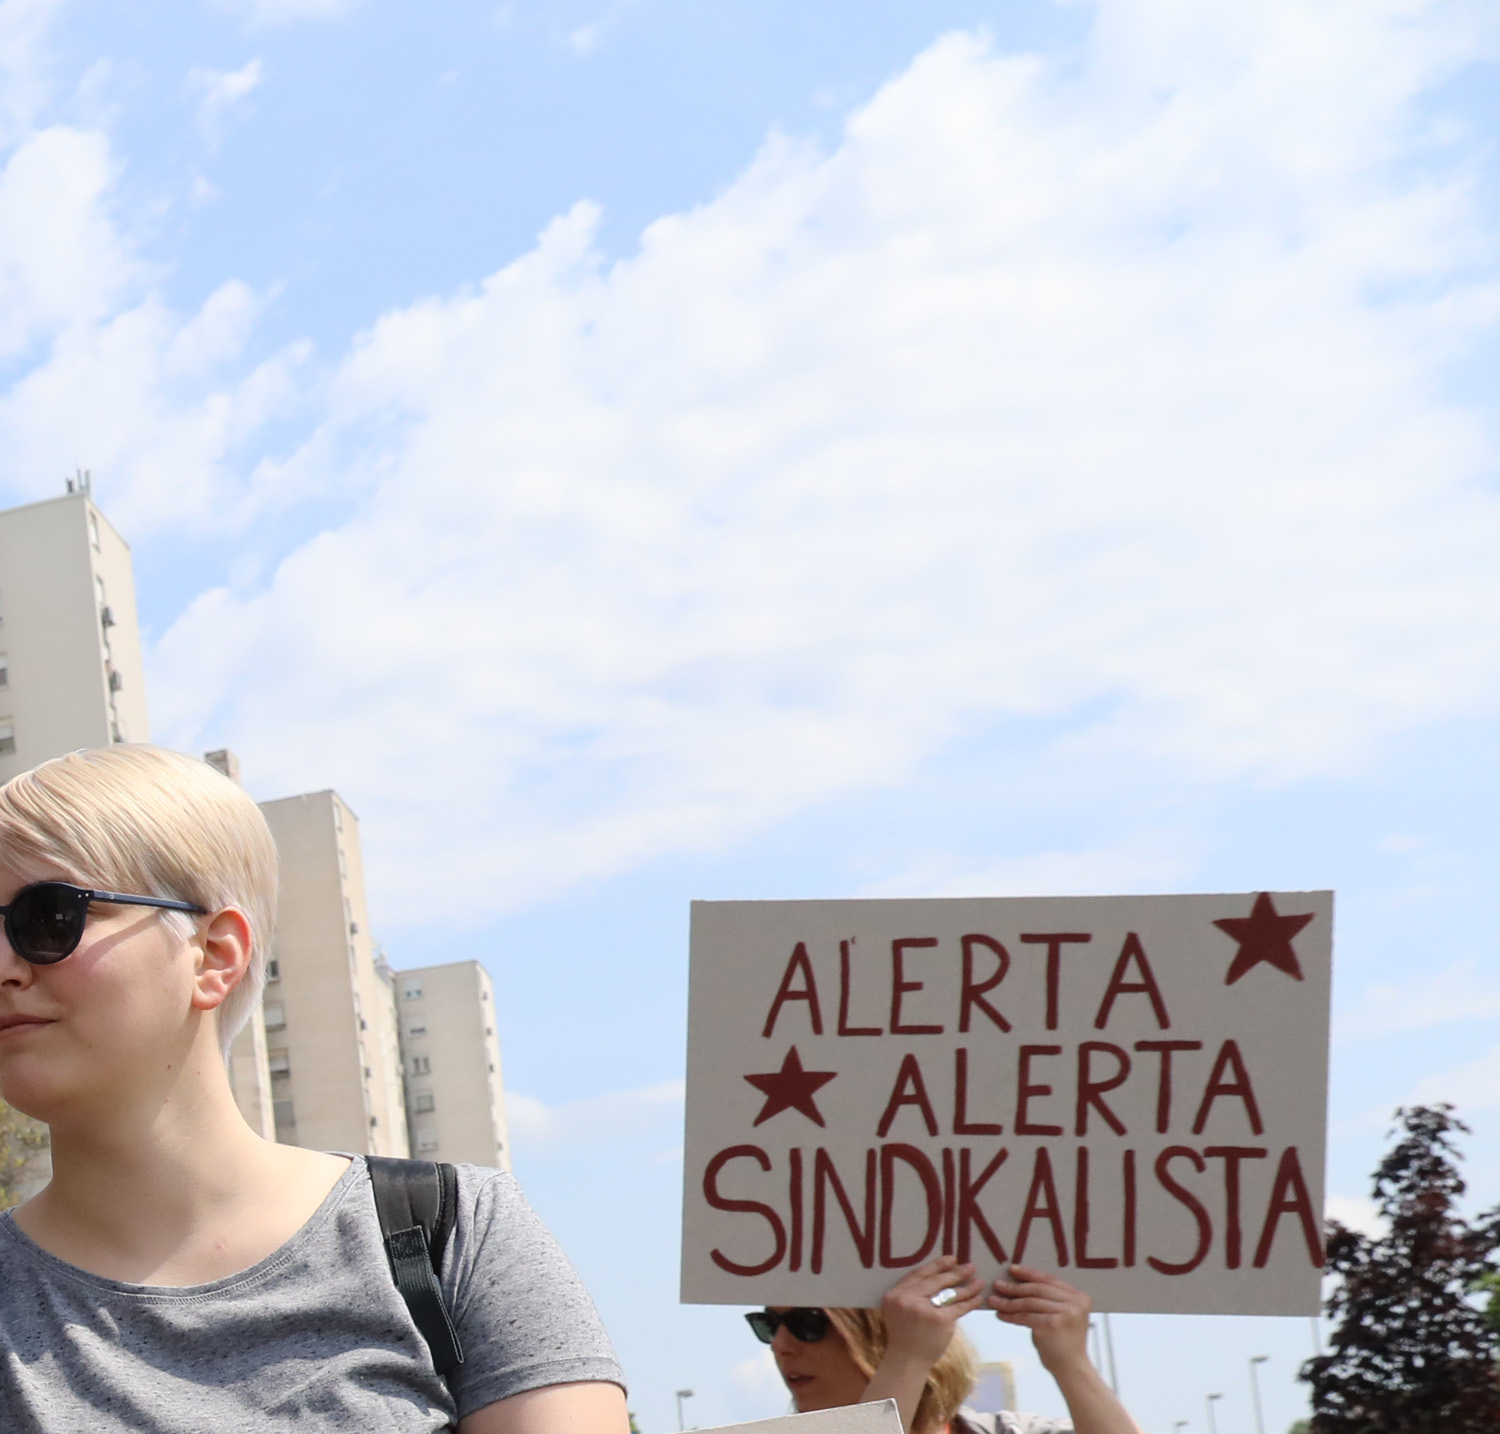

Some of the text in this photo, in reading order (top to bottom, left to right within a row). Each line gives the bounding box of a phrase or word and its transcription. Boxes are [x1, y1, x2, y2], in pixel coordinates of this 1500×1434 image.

[763, 932, 1170, 1039] ALERTA
[877, 1039, 1263, 1138] ALERTA
[703, 1143, 1326, 1276] SINDIKALISTA
